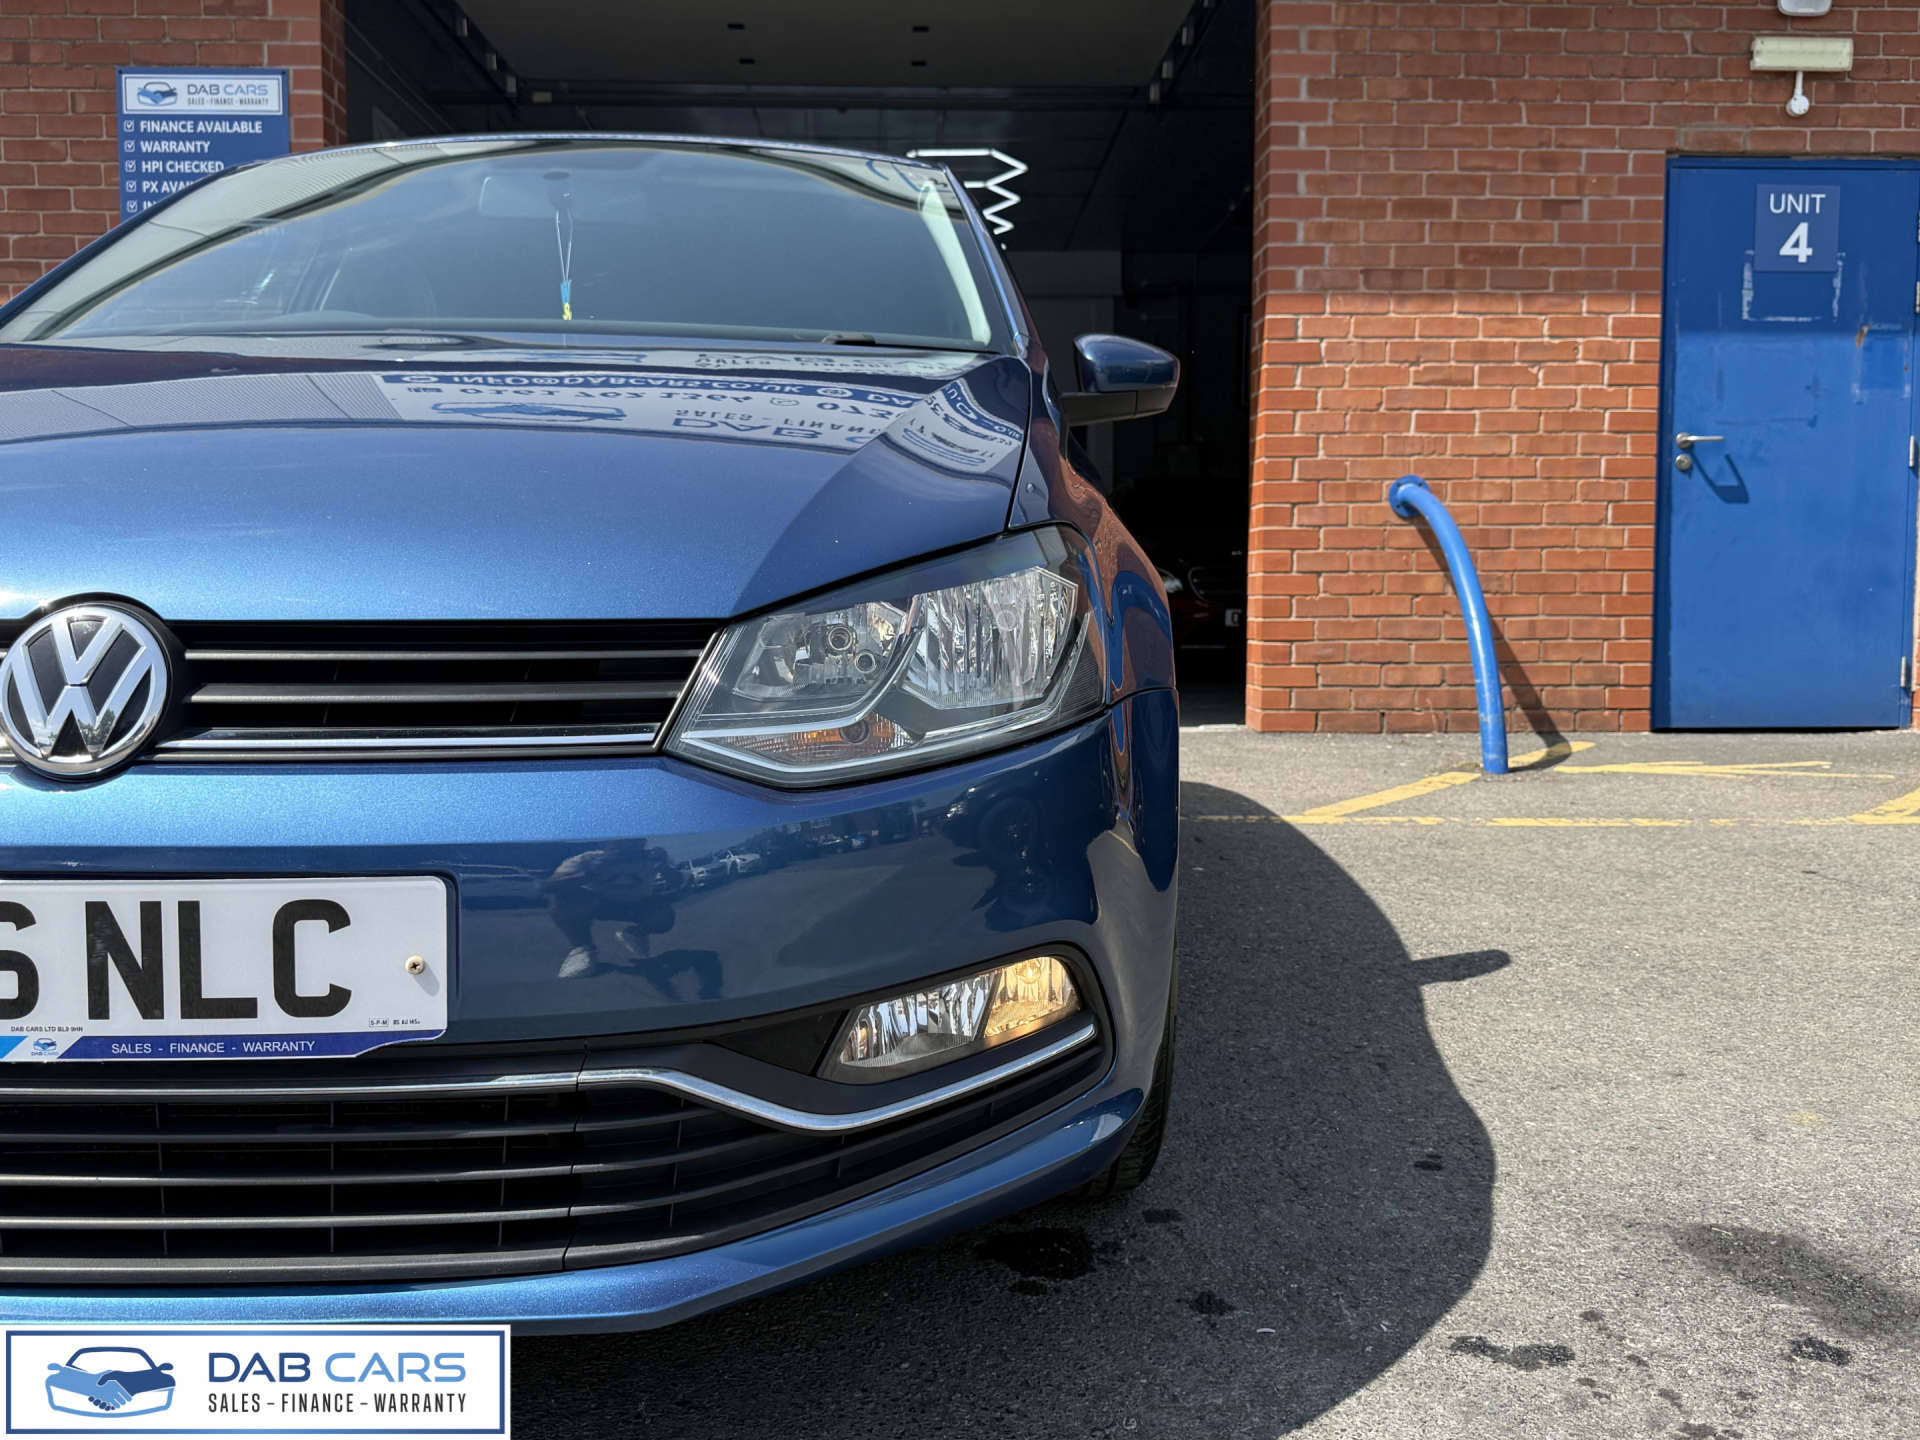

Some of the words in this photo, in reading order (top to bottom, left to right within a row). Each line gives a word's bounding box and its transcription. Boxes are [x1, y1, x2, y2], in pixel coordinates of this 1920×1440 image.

[187, 84, 220, 95] DAB
[223, 84, 269, 95] CARS
[140, 120, 194, 133] FINANCE
[197, 121, 263, 134] AVAILABLE
[140, 141, 211, 153] WARRANTY
[142, 161, 163, 173] HPI
[166, 161, 224, 173] CHECKED
[142, 181, 159, 193] PX
[1769, 193, 1826, 214] UNIT
[1779, 222, 1813, 263] 4
[85, 898, 352, 1020] NLC
[111, 1043, 152, 1054] SALES
[169, 1042, 225, 1053] FINANCE
[243, 1041, 316, 1052] WARRANTY
